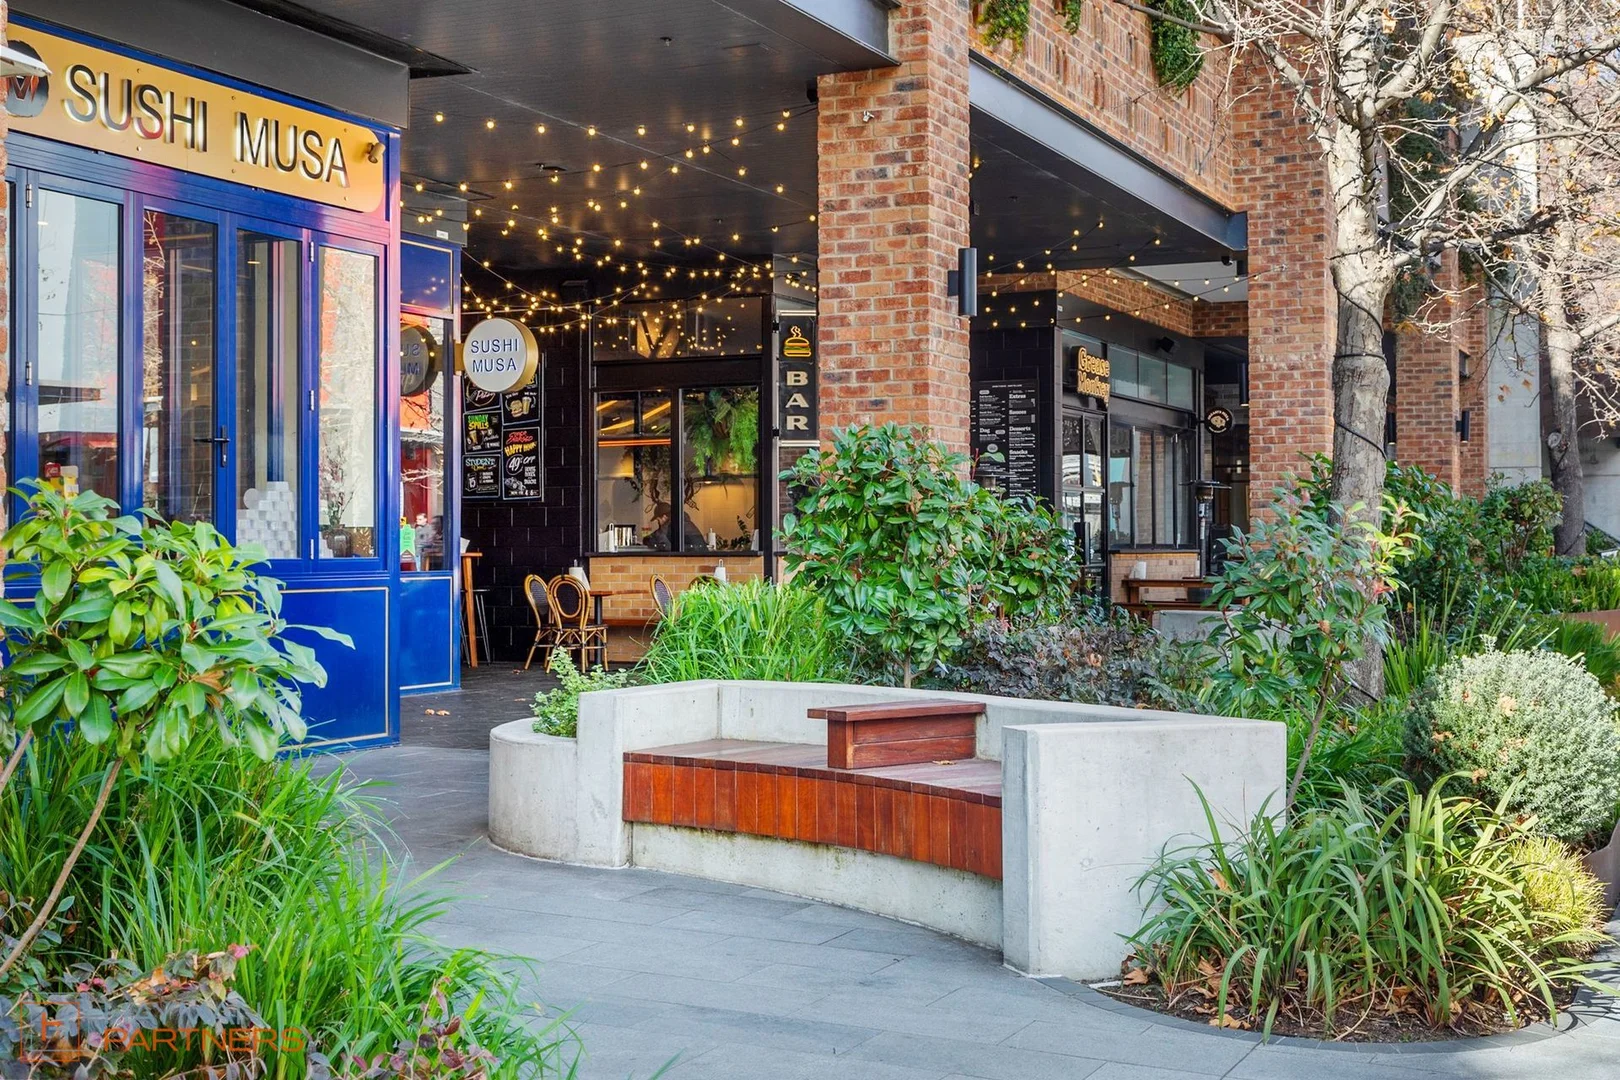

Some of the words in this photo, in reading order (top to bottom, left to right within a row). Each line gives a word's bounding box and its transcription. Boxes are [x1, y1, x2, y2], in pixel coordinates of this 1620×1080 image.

[64, 63, 208, 154] SUSHI
[234, 110, 351, 189] MUSA
[470, 338, 519, 354] SUSHI
[472, 357, 517, 373] MUSA
[1078, 347, 1111, 378] Grease
[1077, 370, 1111, 404] Monkey
[785, 371, 809, 431] BAR
[465, 457, 497, 467] STUDENT
[504, 444, 523, 458] HAPPY
